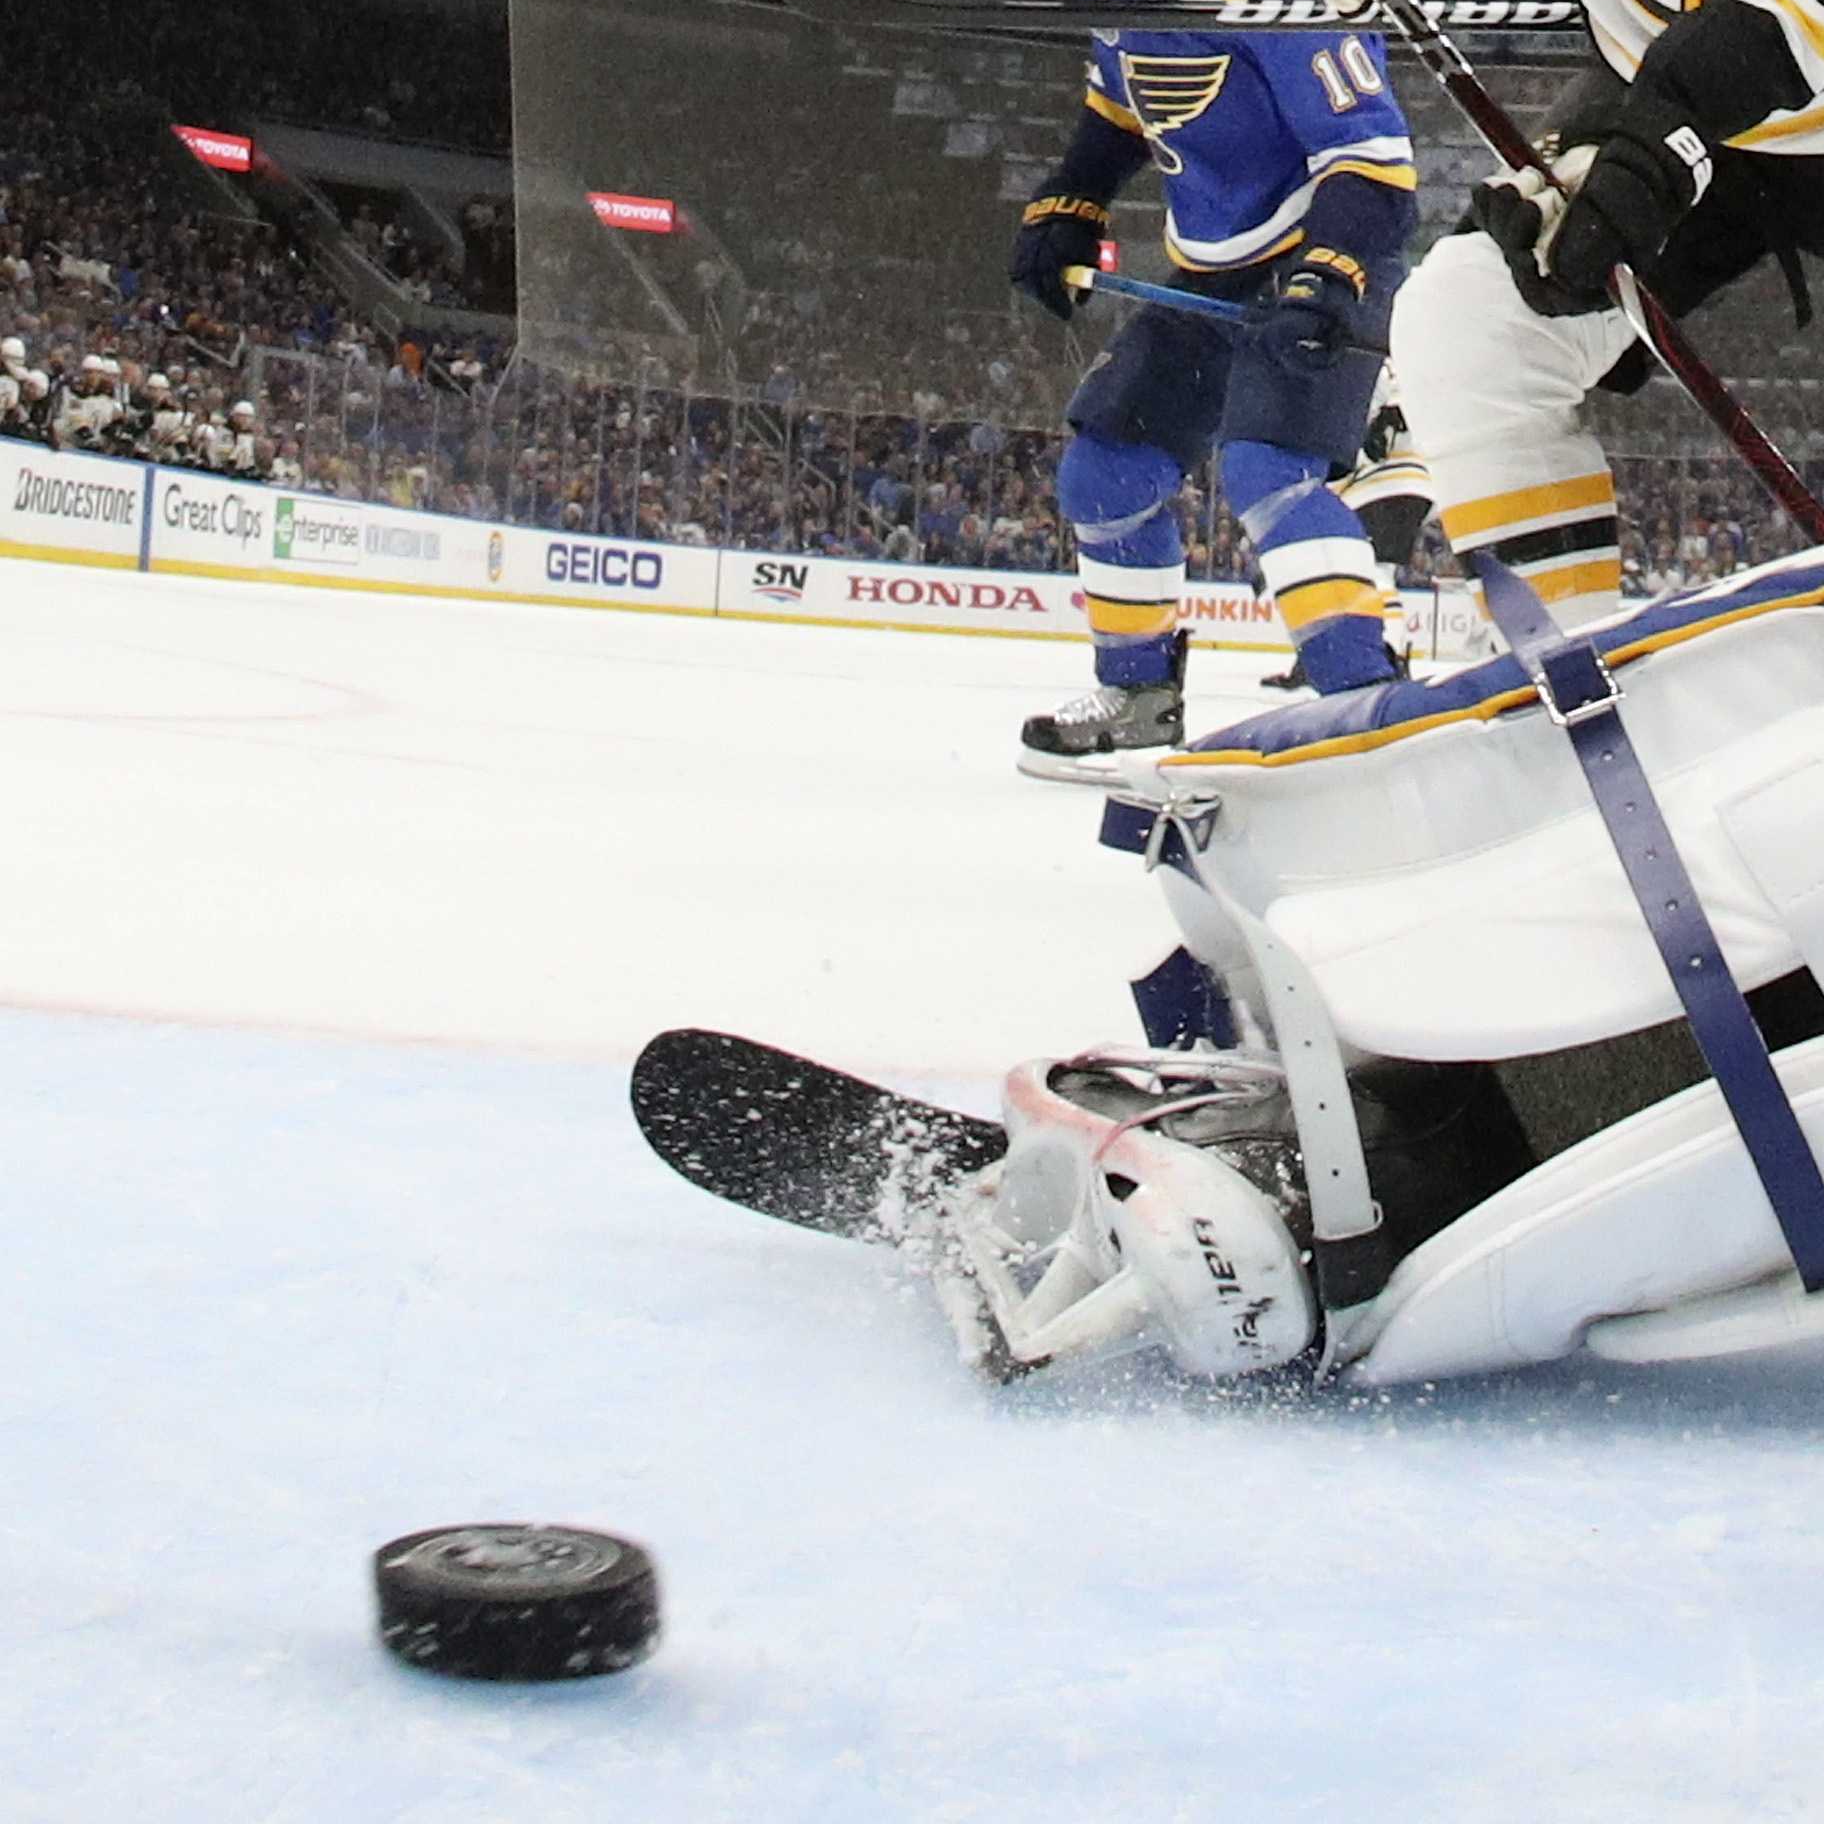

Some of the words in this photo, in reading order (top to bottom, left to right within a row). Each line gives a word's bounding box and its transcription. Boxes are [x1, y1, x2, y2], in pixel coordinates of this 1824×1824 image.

[1311, 32, 1386, 114] 10
[612, 203, 671, 223] TOYOTA
[14, 467, 136, 526] BRIDGESTONE
[164, 484, 218, 534] Great
[221, 494, 263, 551] Clips
[277, 513, 359, 546] enterprise
[546, 542, 663, 589] GEICO
[752, 561, 808, 589] SN
[847, 575, 1048, 613] HONDA
[1175, 597, 1273, 622] UNKIN
